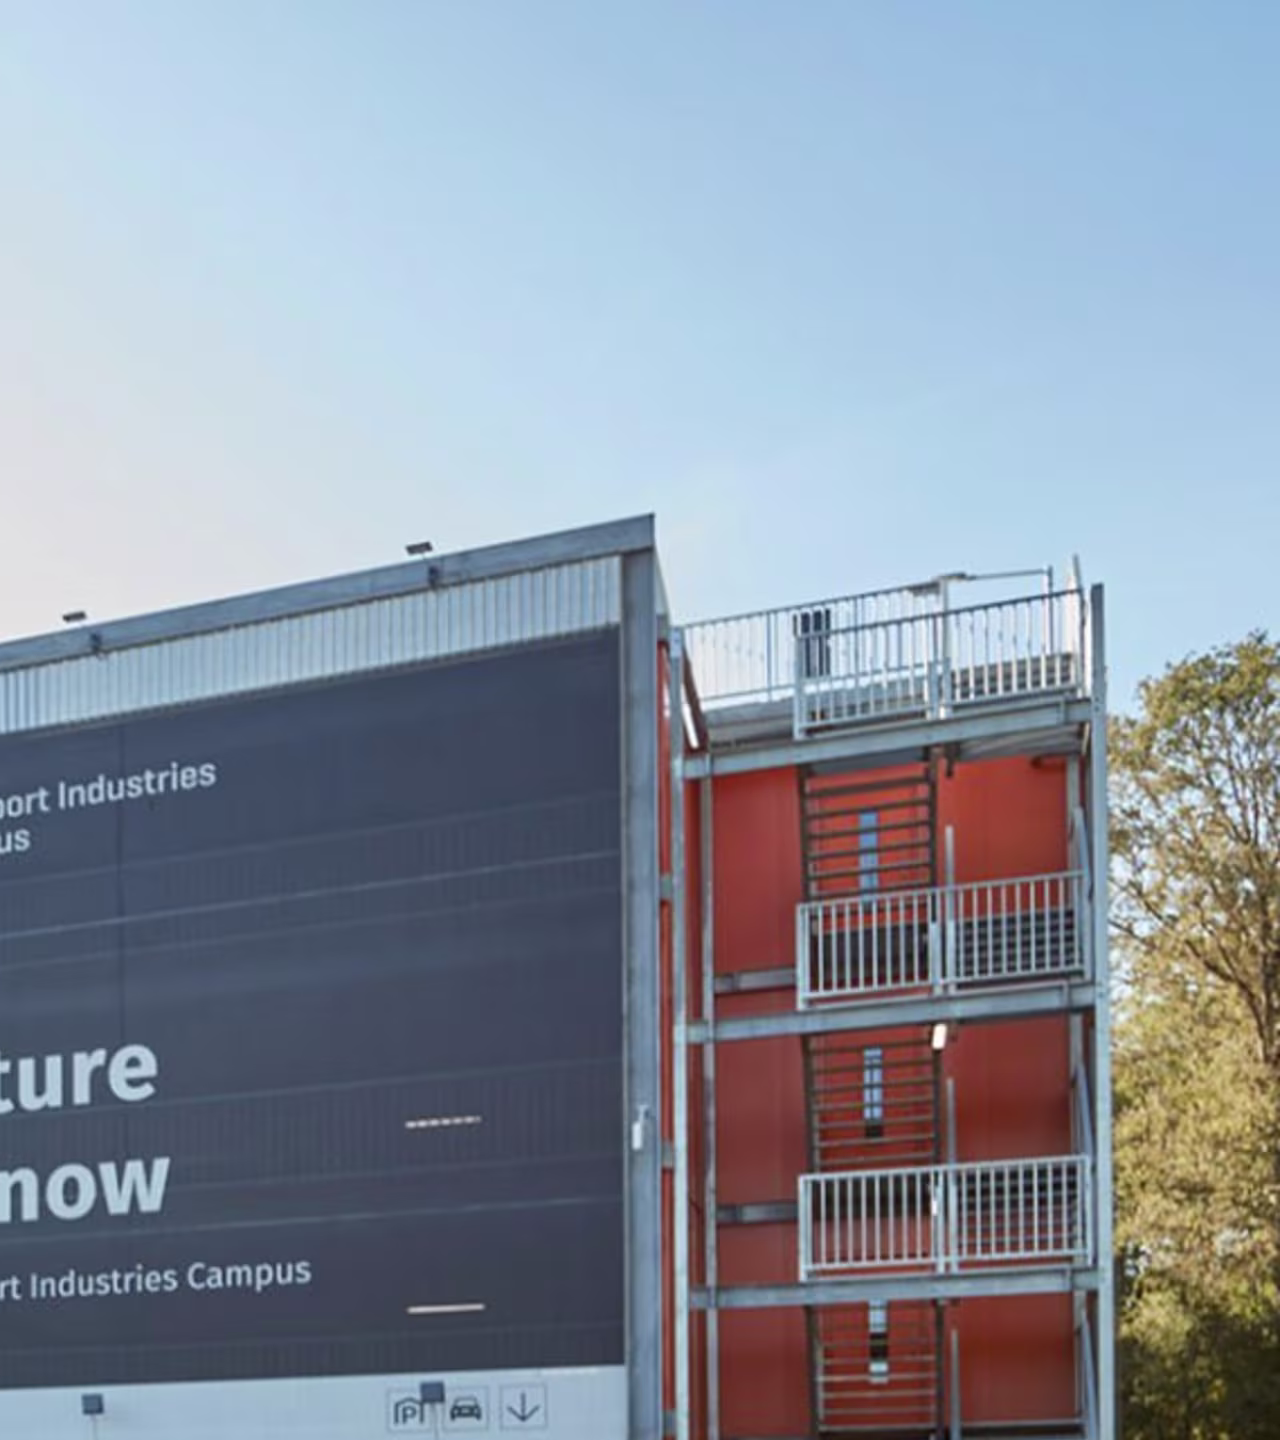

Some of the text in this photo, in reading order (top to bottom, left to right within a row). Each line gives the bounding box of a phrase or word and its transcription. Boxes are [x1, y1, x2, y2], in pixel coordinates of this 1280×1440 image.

[58, 761, 217, 809] Industries
[30, 1264, 178, 1298] Industries
[187, 1260, 312, 1292] Campus
